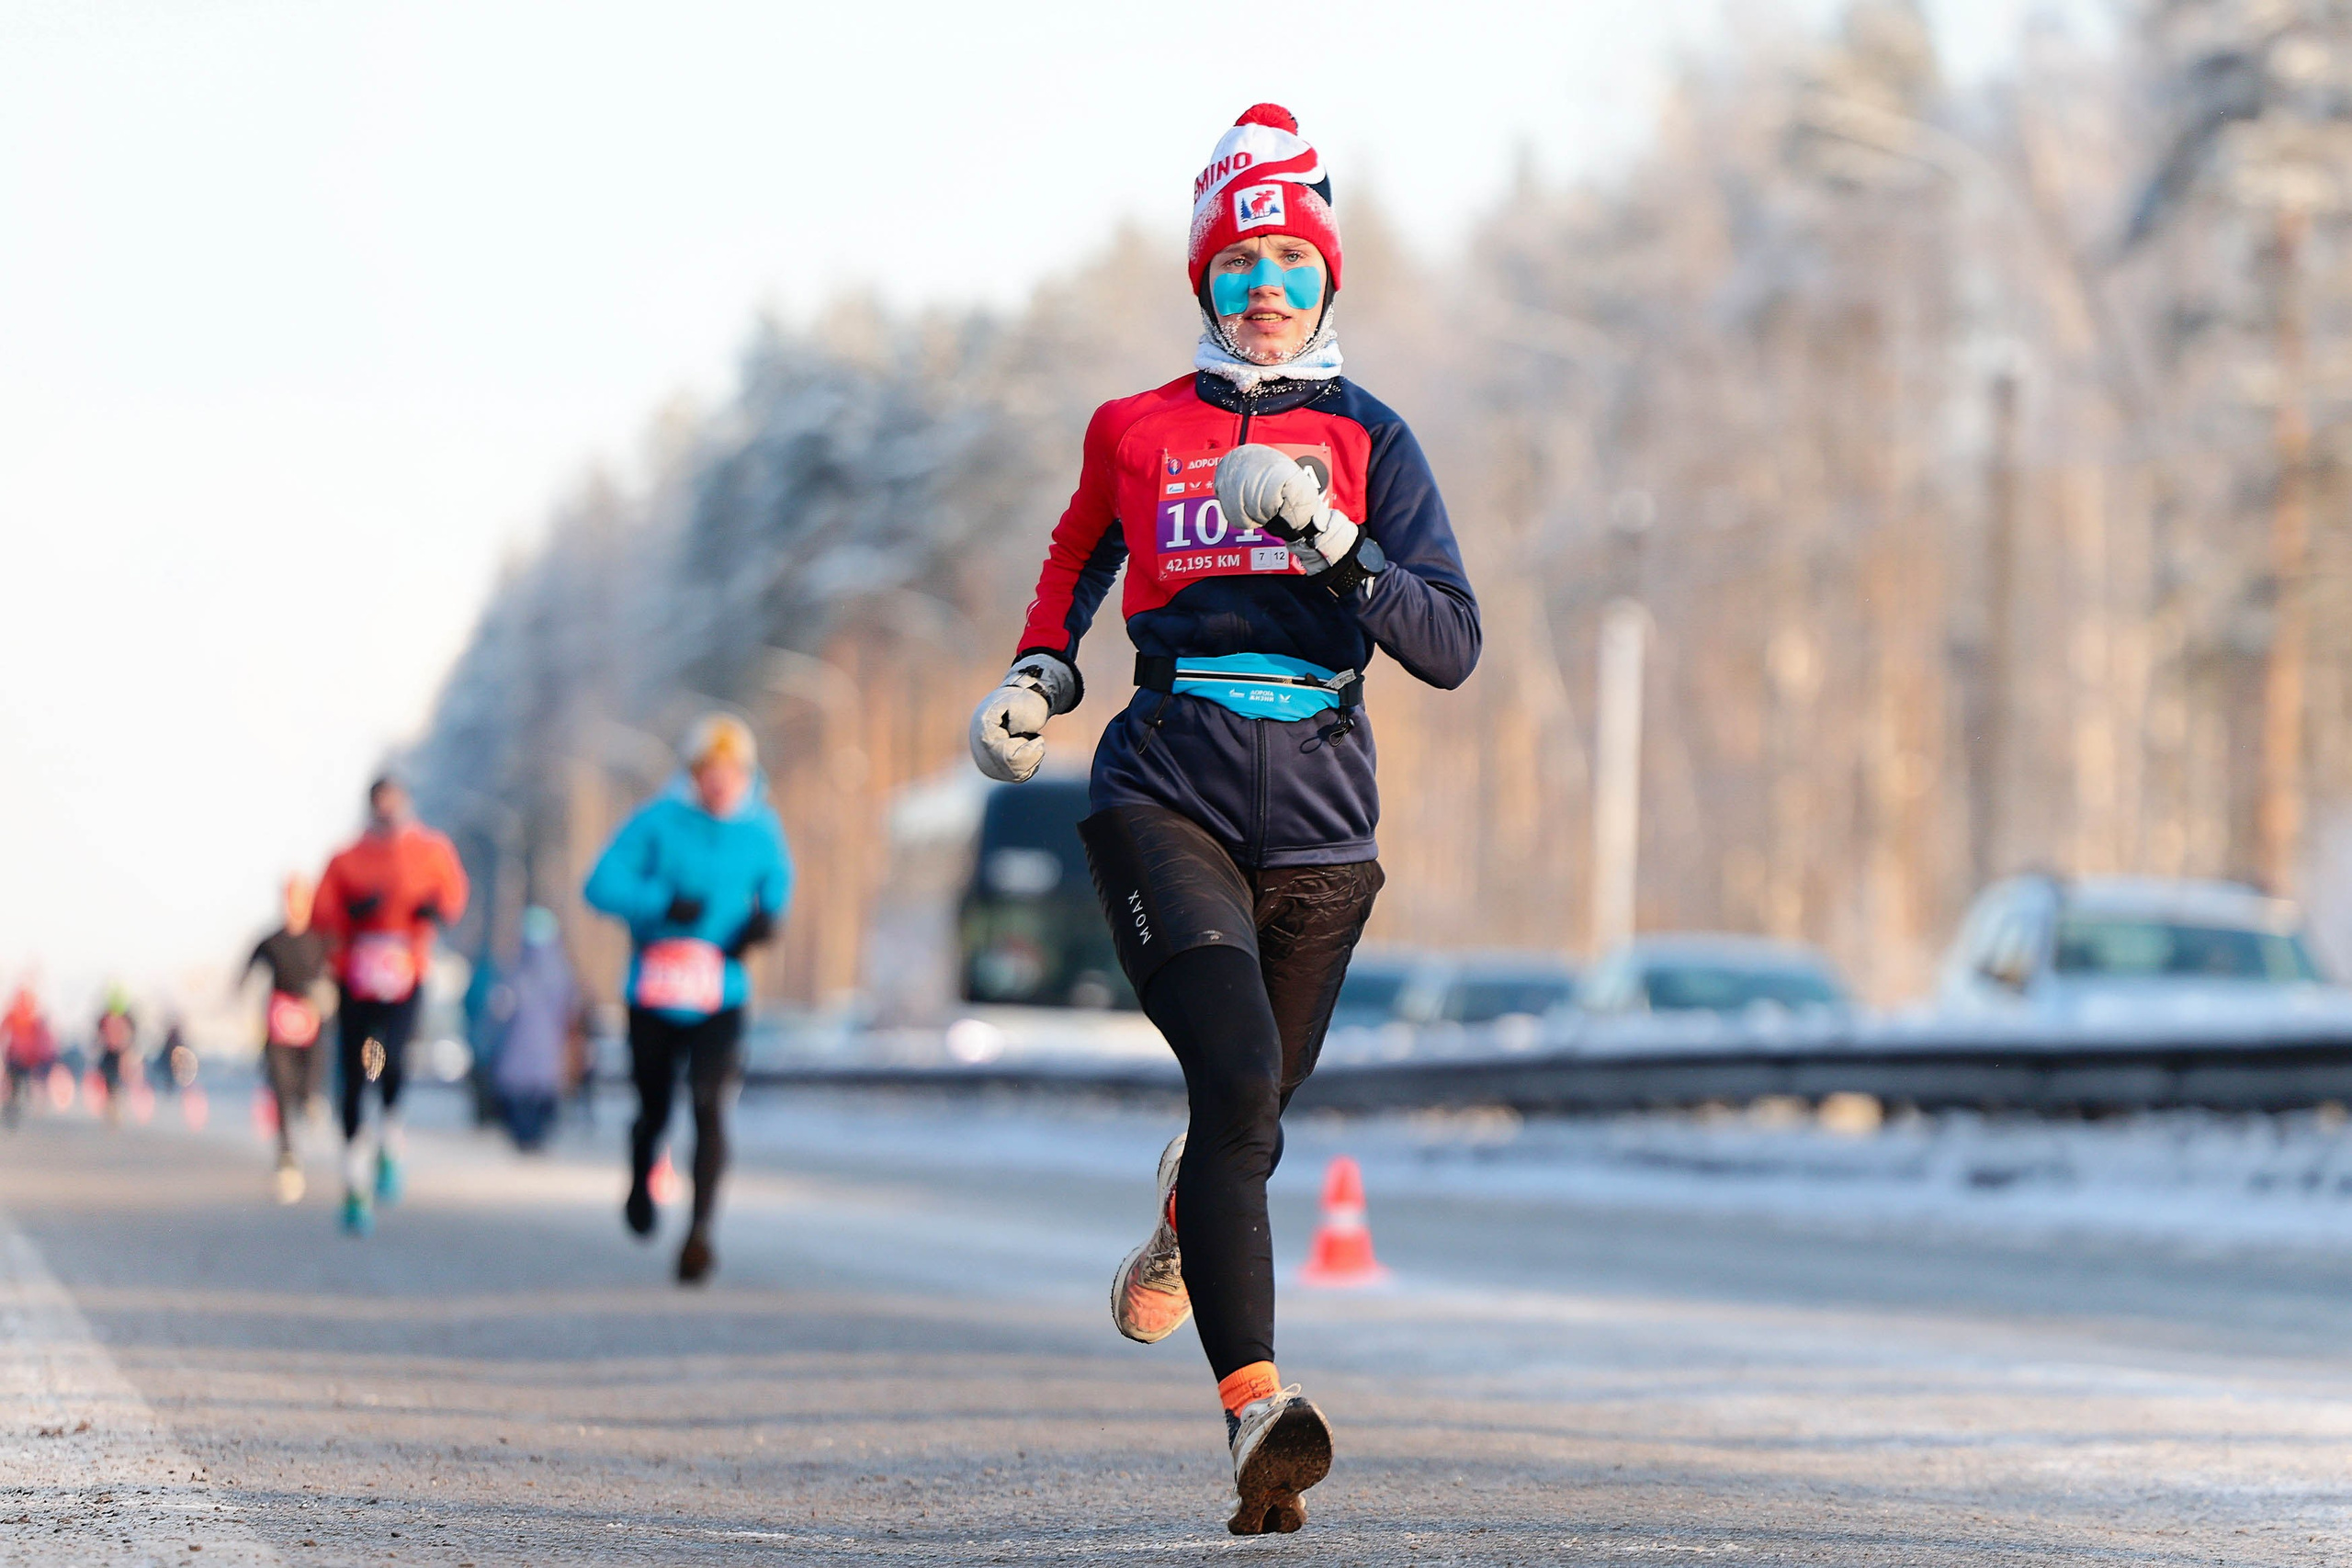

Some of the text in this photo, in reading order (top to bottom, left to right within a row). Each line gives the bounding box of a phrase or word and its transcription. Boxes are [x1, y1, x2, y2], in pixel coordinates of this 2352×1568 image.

[1194, 152, 1252, 204] MINO
[1187, 457, 1223, 469] ДОРОГ
[1259, 551, 1285, 560] 7 12
[1166, 556, 1213, 572] 42,195
[1128, 889, 1152, 945] MOAX
